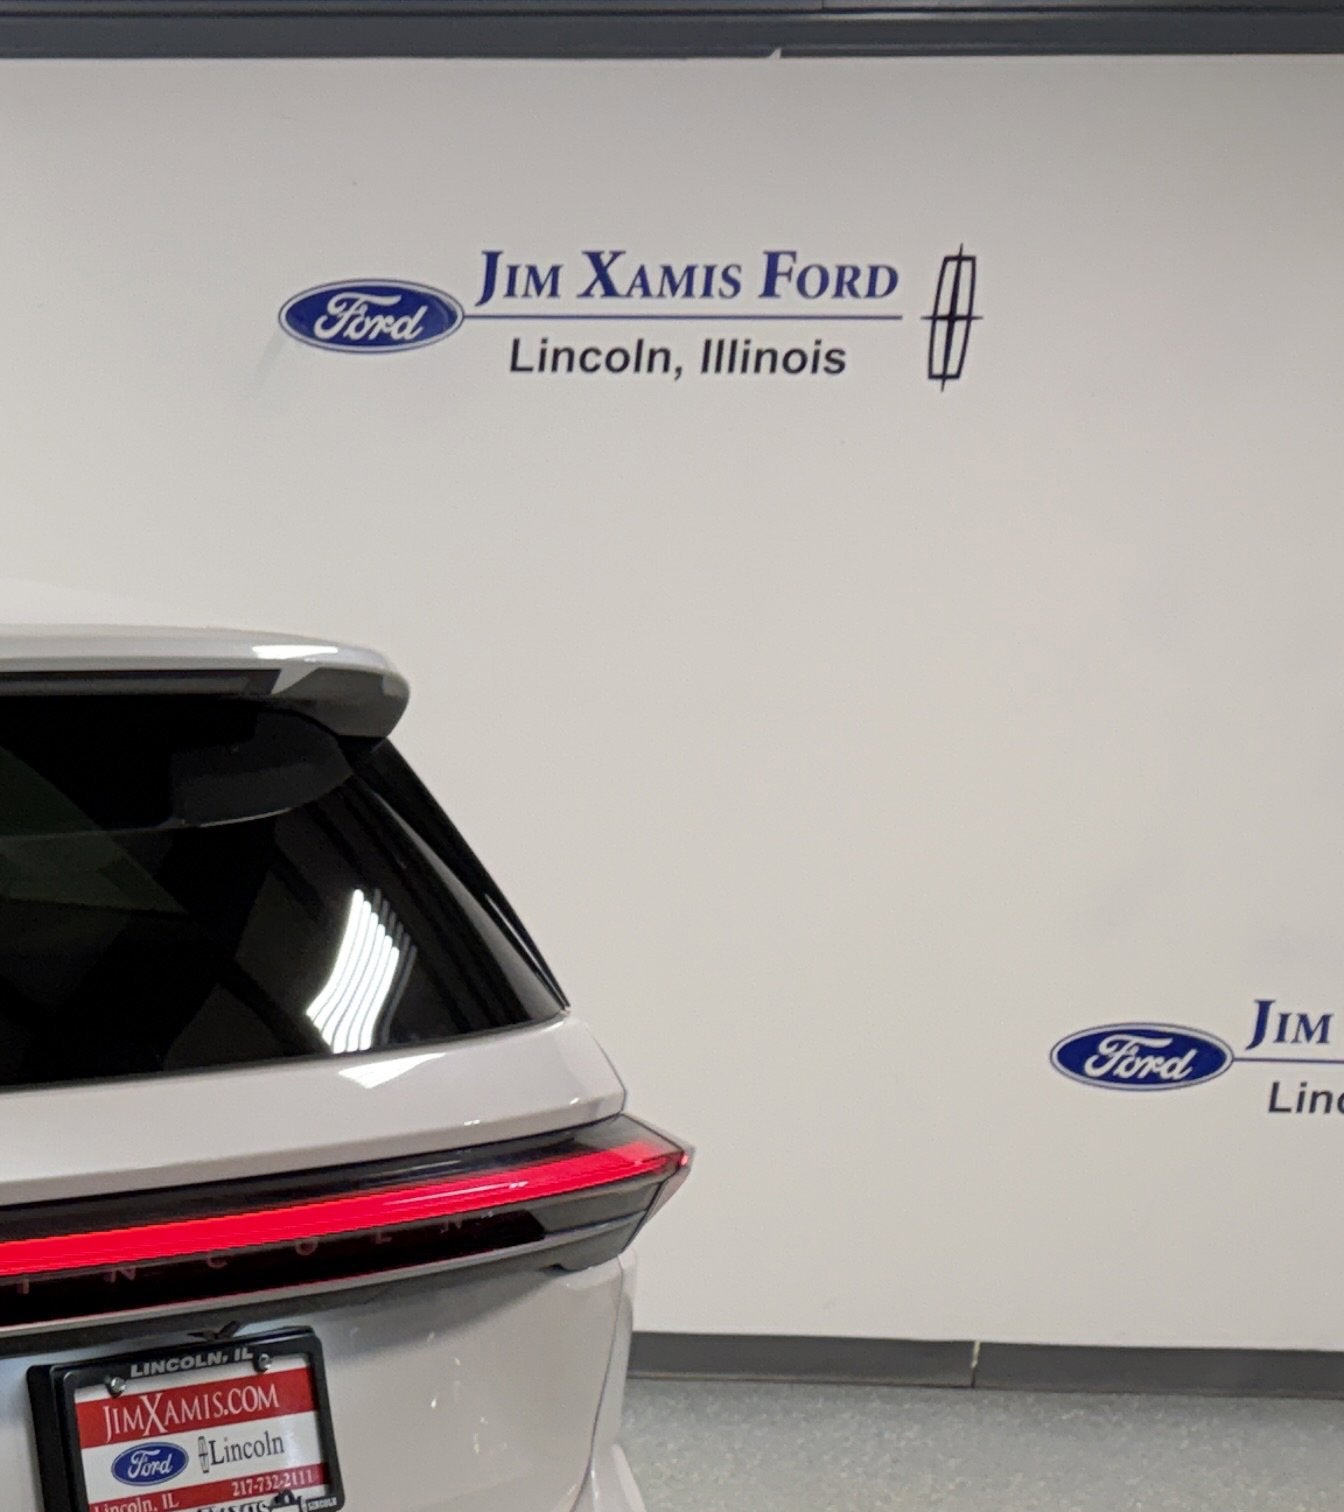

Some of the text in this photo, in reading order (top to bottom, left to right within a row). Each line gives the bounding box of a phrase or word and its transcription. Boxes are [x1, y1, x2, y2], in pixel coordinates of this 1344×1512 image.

[474, 250, 901, 306] JIM XAMIS FORD
[314, 291, 426, 342] Ford
[508, 336, 848, 381] Lincoln, Illinois
[1245, 998, 1335, 1051] JIM
[1083, 1033, 1194, 1082] Ford
[234, 1346, 255, 1362] IL
[102, 1383, 280, 1443] JIMXAMIS.COM
[209, 1430, 285, 1466] Lincoln
[162, 1491, 180, 1509] IL
[231, 1468, 315, 1498] 217-732-2111
